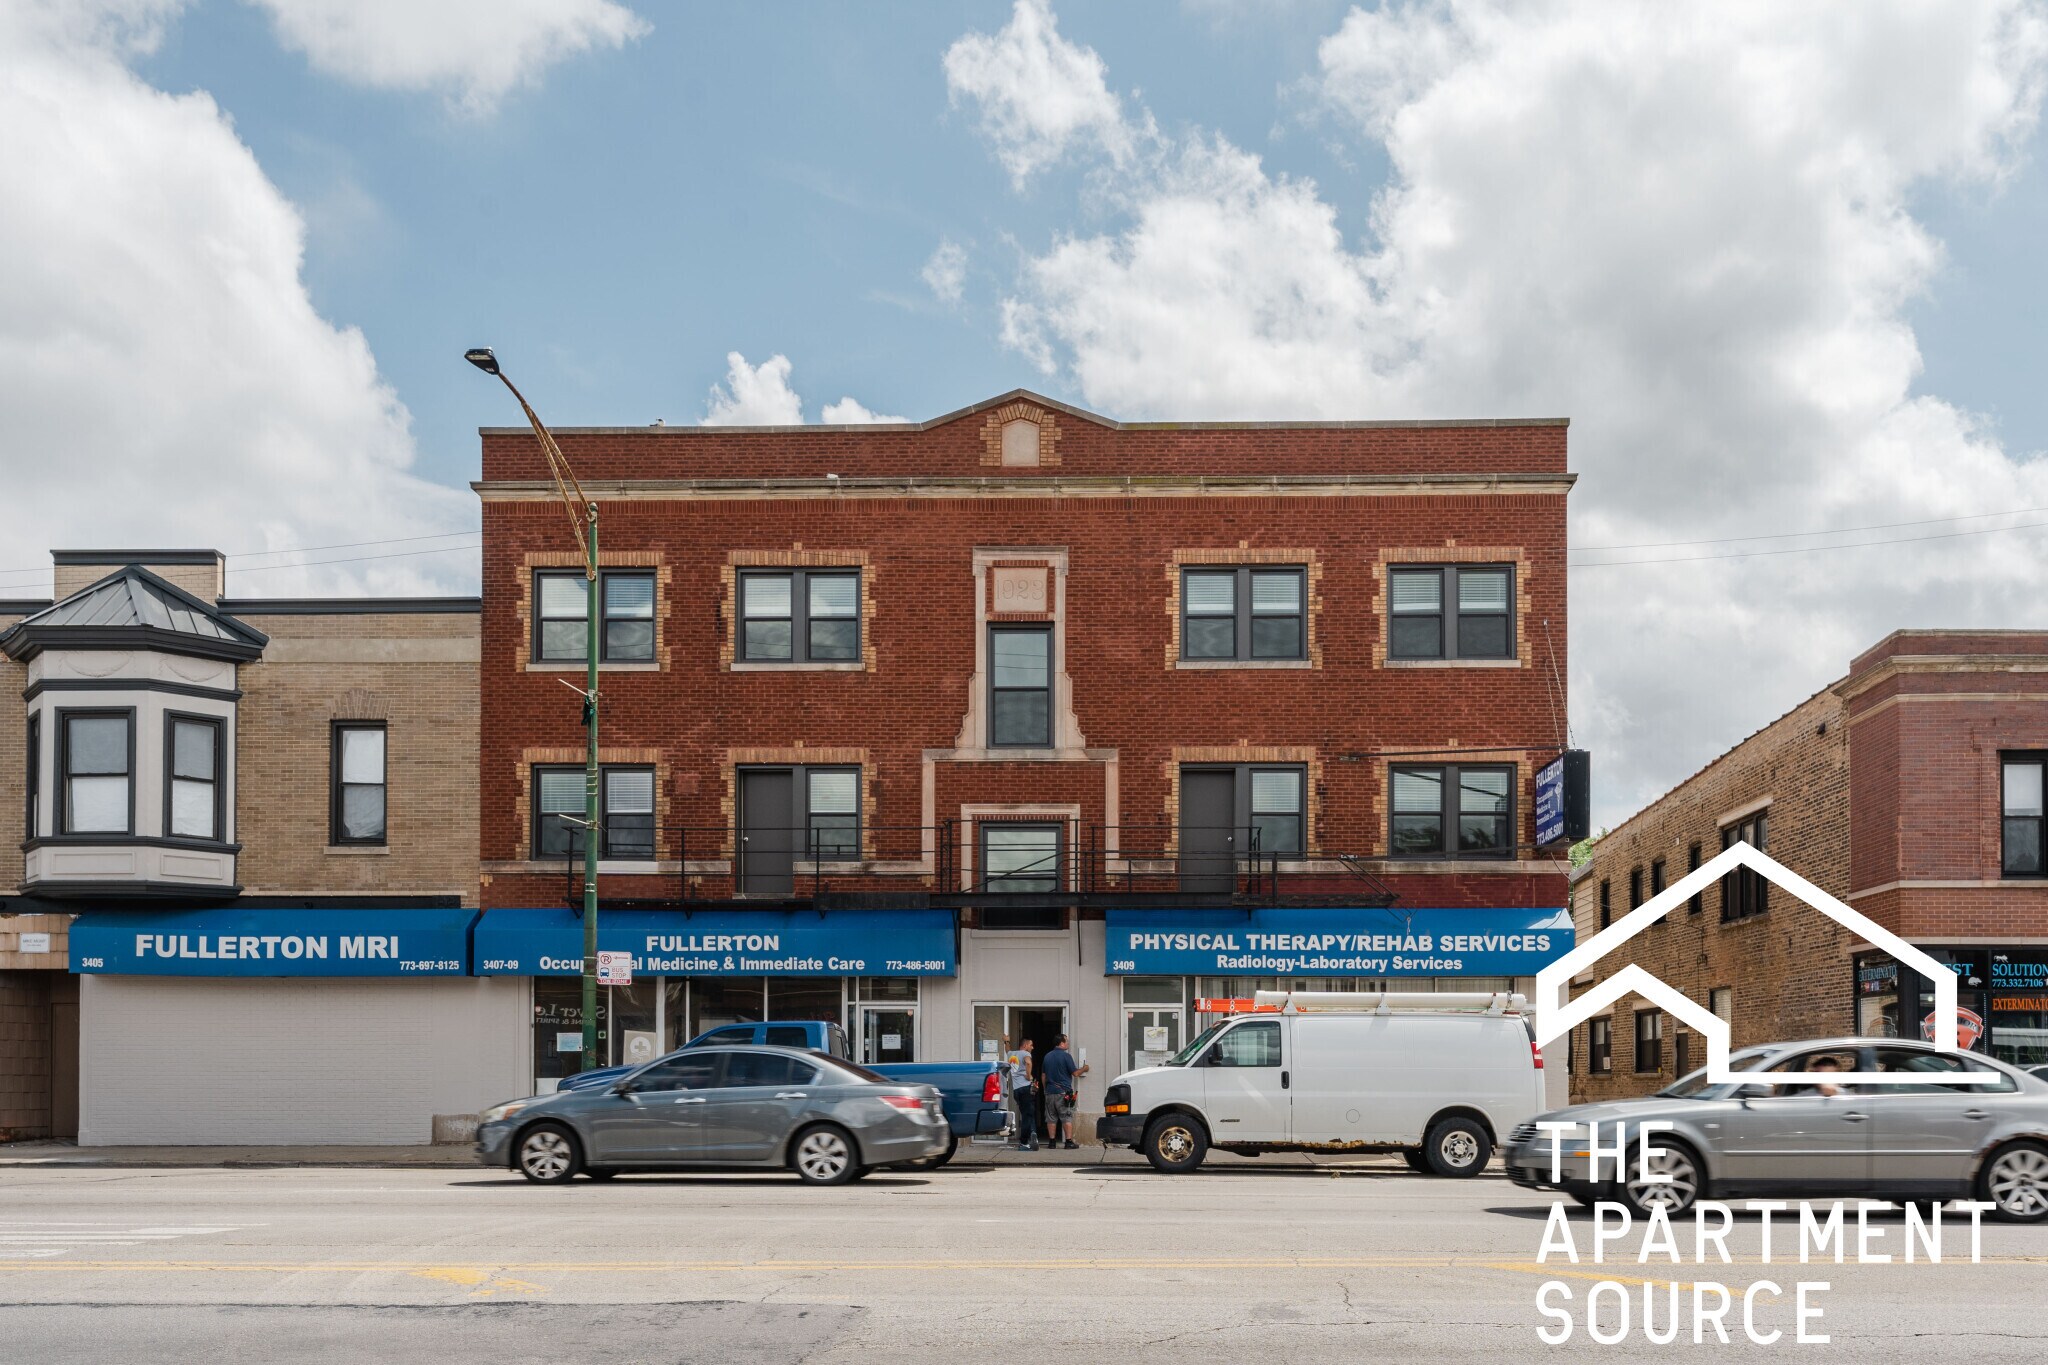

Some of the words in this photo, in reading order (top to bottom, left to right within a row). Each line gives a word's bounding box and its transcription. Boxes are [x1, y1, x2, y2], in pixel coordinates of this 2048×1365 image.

[996, 580, 1045, 600] 1923
[1536, 757, 1564, 788] FULLERTON
[136, 934, 328, 959] FULLERTON
[339, 935, 399, 959] MRI
[646, 934, 779, 952] FULLERTON
[1130, 933, 1240, 951] PHYSICAL
[1245, 933, 1433, 952] THERAPY/REHAB
[1439, 934, 1551, 952] SERVICES
[82, 957, 104, 968] 3405
[399, 960, 460, 971] 773-697-8125
[483, 959, 519, 970] 3407-09
[539, 956, 643, 973] Occual
[647, 957, 718, 971] Medicine
[723, 956, 736, 971] &
[740, 956, 824, 971] Immediate
[828, 956, 866, 971] Care
[885, 960, 945, 971] 773-486-5001
[1113, 960, 1135, 971] 3409
[1217, 954, 1389, 973] Radiology-Laboratory
[1392, 955, 1463, 970] Services
[1992, 978, 2044, 988] 773.332.7106
